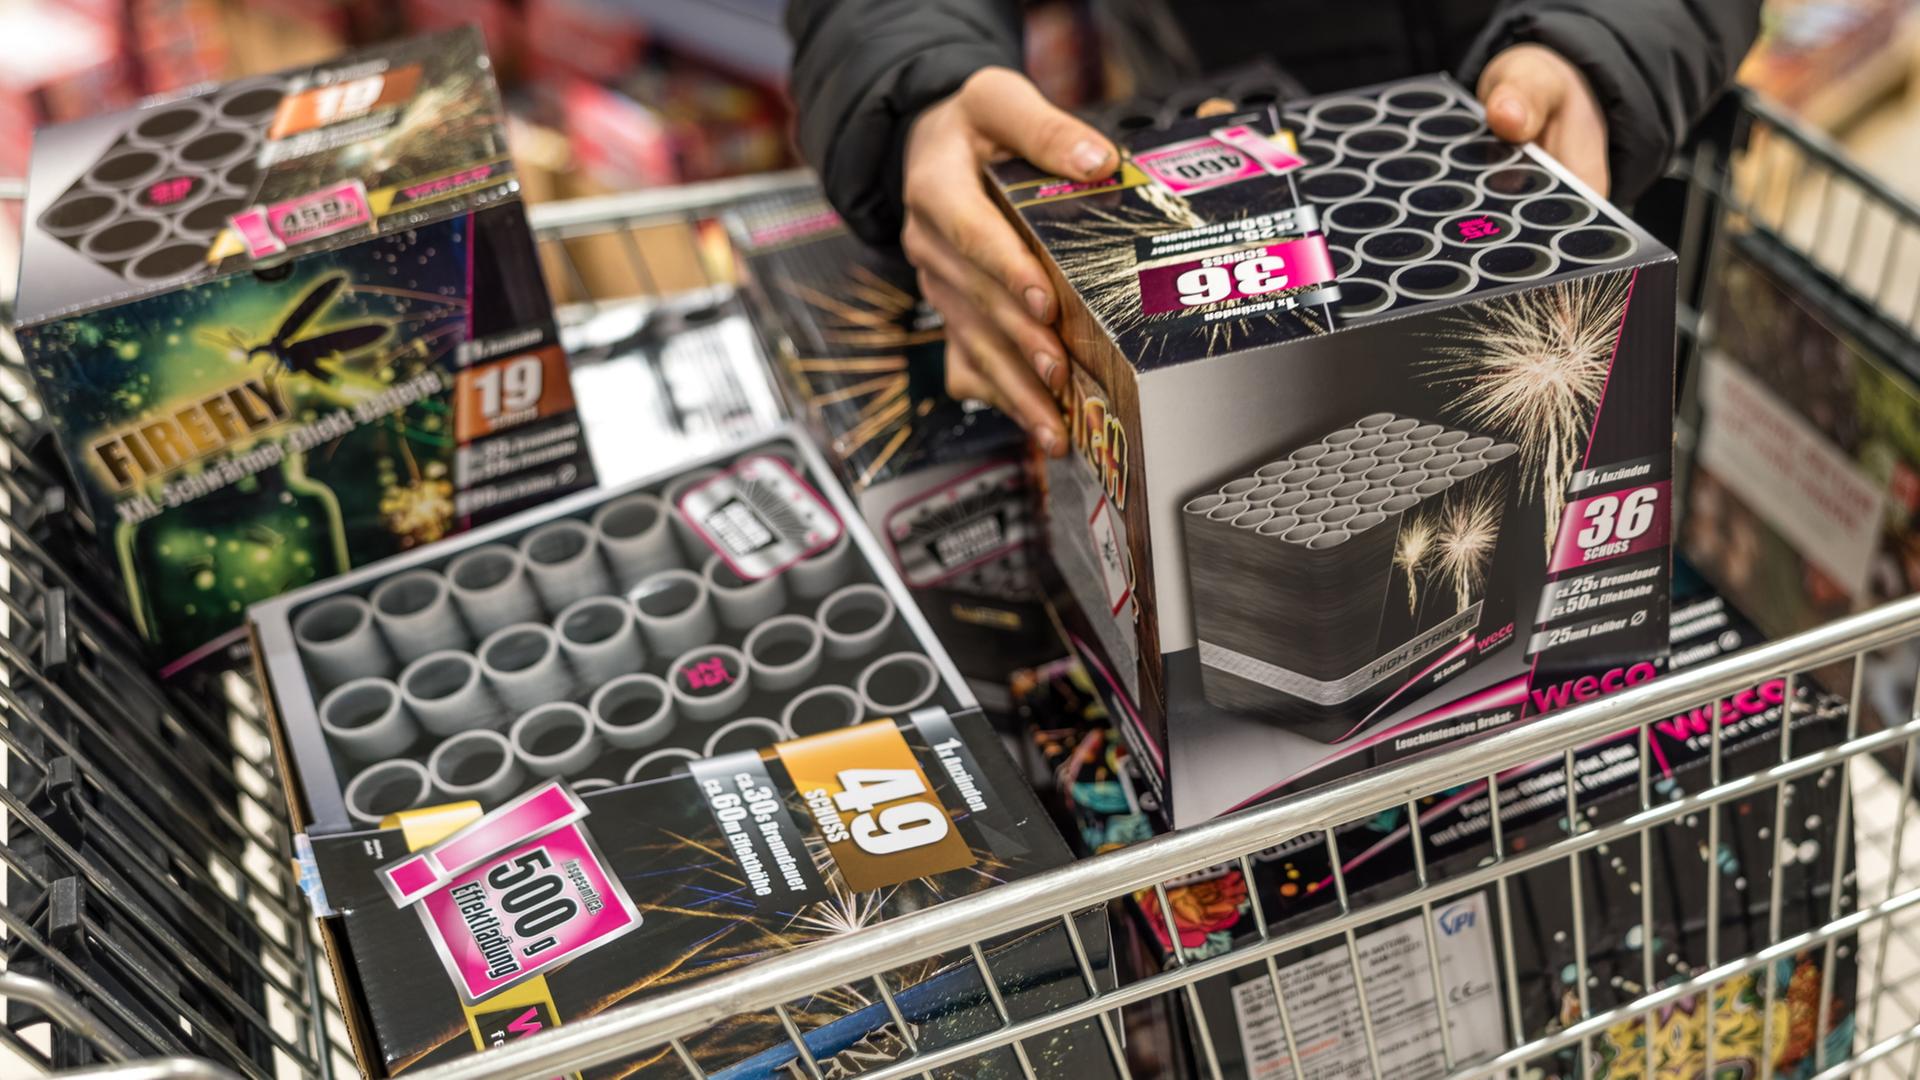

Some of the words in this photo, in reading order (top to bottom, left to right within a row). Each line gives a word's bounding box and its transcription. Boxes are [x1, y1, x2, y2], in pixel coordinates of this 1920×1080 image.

[1176, 154, 1241, 183] 460
[1176, 255, 1288, 305] 36
[1200, 247, 1268, 268] SCHUSS
[1203, 298, 1276, 322] Anzünden
[474, 354, 543, 418] 19
[95, 374, 291, 491] FIREFLY
[1600, 463, 1651, 484] Anzünden
[1576, 487, 1659, 549] 36
[1583, 539, 1630, 561] SCHUSS
[1598, 584, 1654, 606] Effekthöhe
[1599, 565, 1661, 589] Brenndauer
[1371, 652, 1409, 680] HIGH
[1411, 613, 1476, 654] STRIKER
[1476, 622, 1515, 651] weco
[1547, 626, 1589, 647] 25mm
[1588, 618, 1627, 636] Kaliber
[1531, 661, 1657, 714] weco
[1395, 720, 1477, 751] Leuchtintensive
[942, 756, 988, 812] Anzünden
[804, 788, 850, 843] SCHUSS
[832, 768, 948, 855] 49
[730, 832, 774, 896] Effekthöhe
[761, 821, 808, 892] Brenndauer
[487, 847, 578, 939] 500
[450, 881, 521, 979] Effektladung
[523, 936, 558, 957] g
